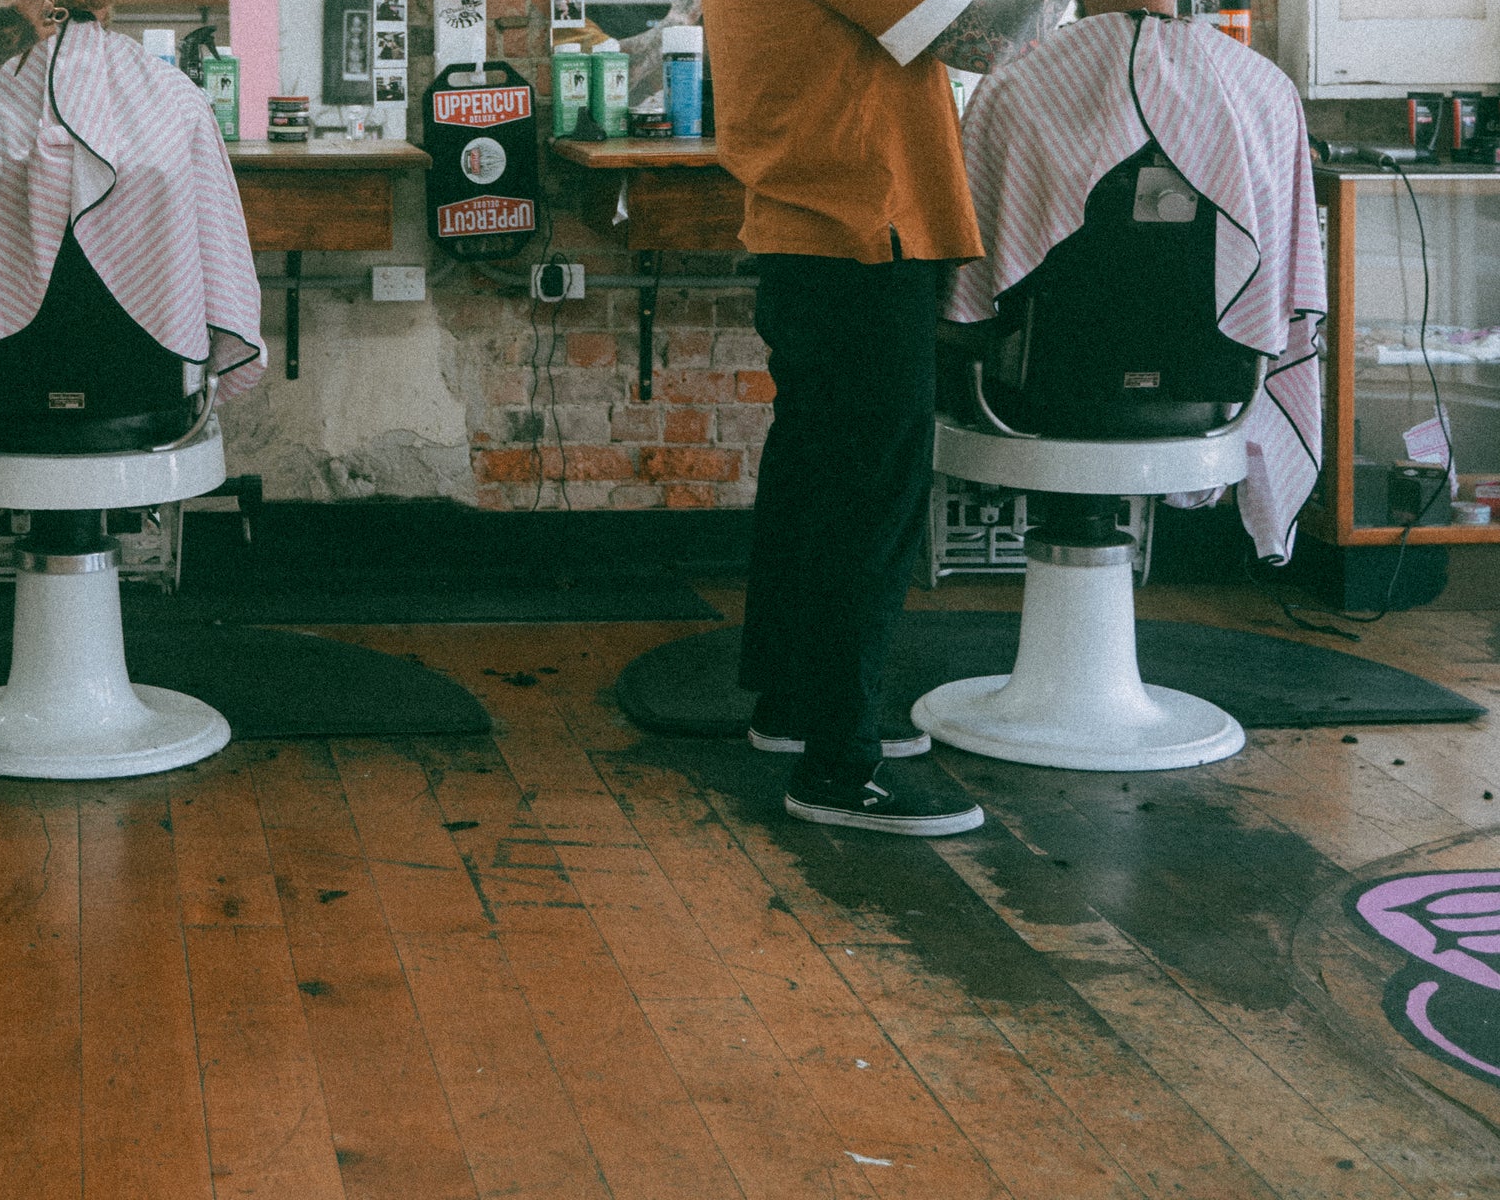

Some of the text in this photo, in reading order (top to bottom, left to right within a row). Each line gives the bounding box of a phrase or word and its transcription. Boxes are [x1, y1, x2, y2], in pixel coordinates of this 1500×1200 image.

[437, 91, 527, 120] UPPERCUT
[469, 114, 497, 124] DELUXE
[442, 202, 531, 233] UPPERCUT
